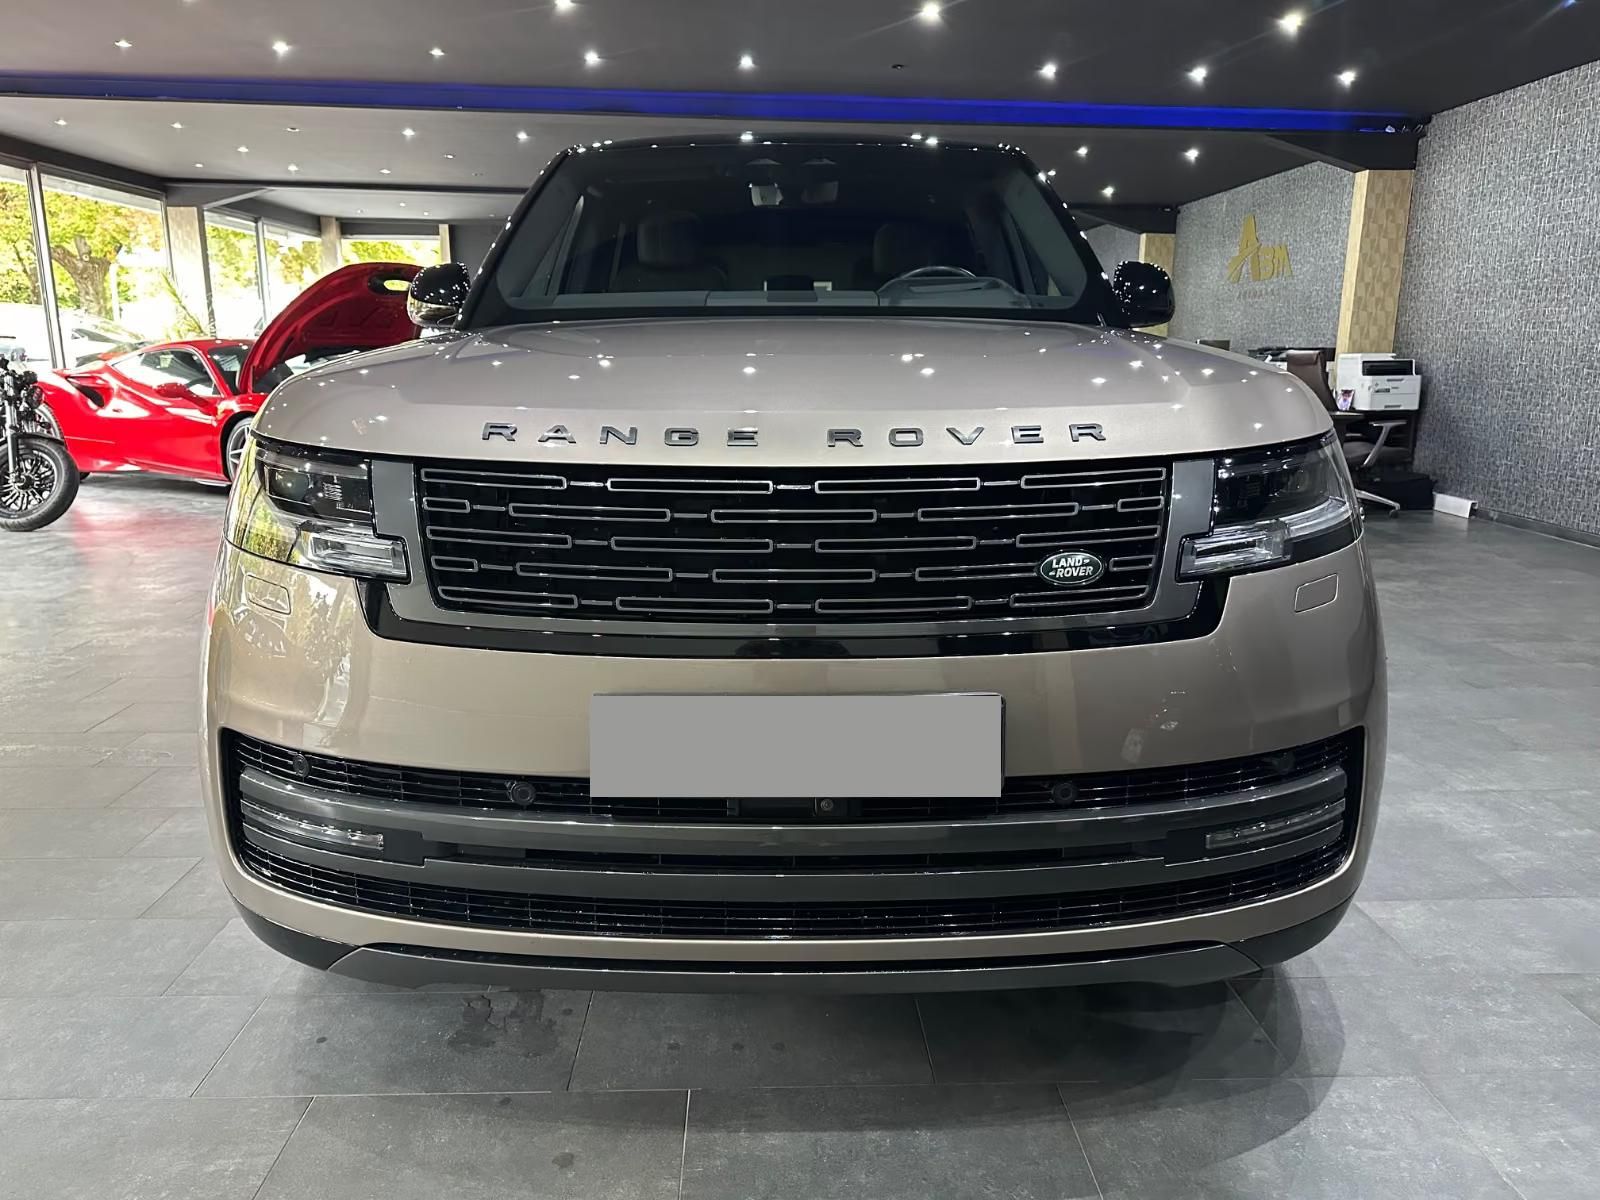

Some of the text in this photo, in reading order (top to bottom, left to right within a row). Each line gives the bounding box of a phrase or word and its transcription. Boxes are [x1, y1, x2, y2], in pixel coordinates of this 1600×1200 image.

[482, 422, 1106, 447] RANGE ROVER
[1052, 557, 1082, 568] LAND
[1056, 566, 1093, 577] ROVER
